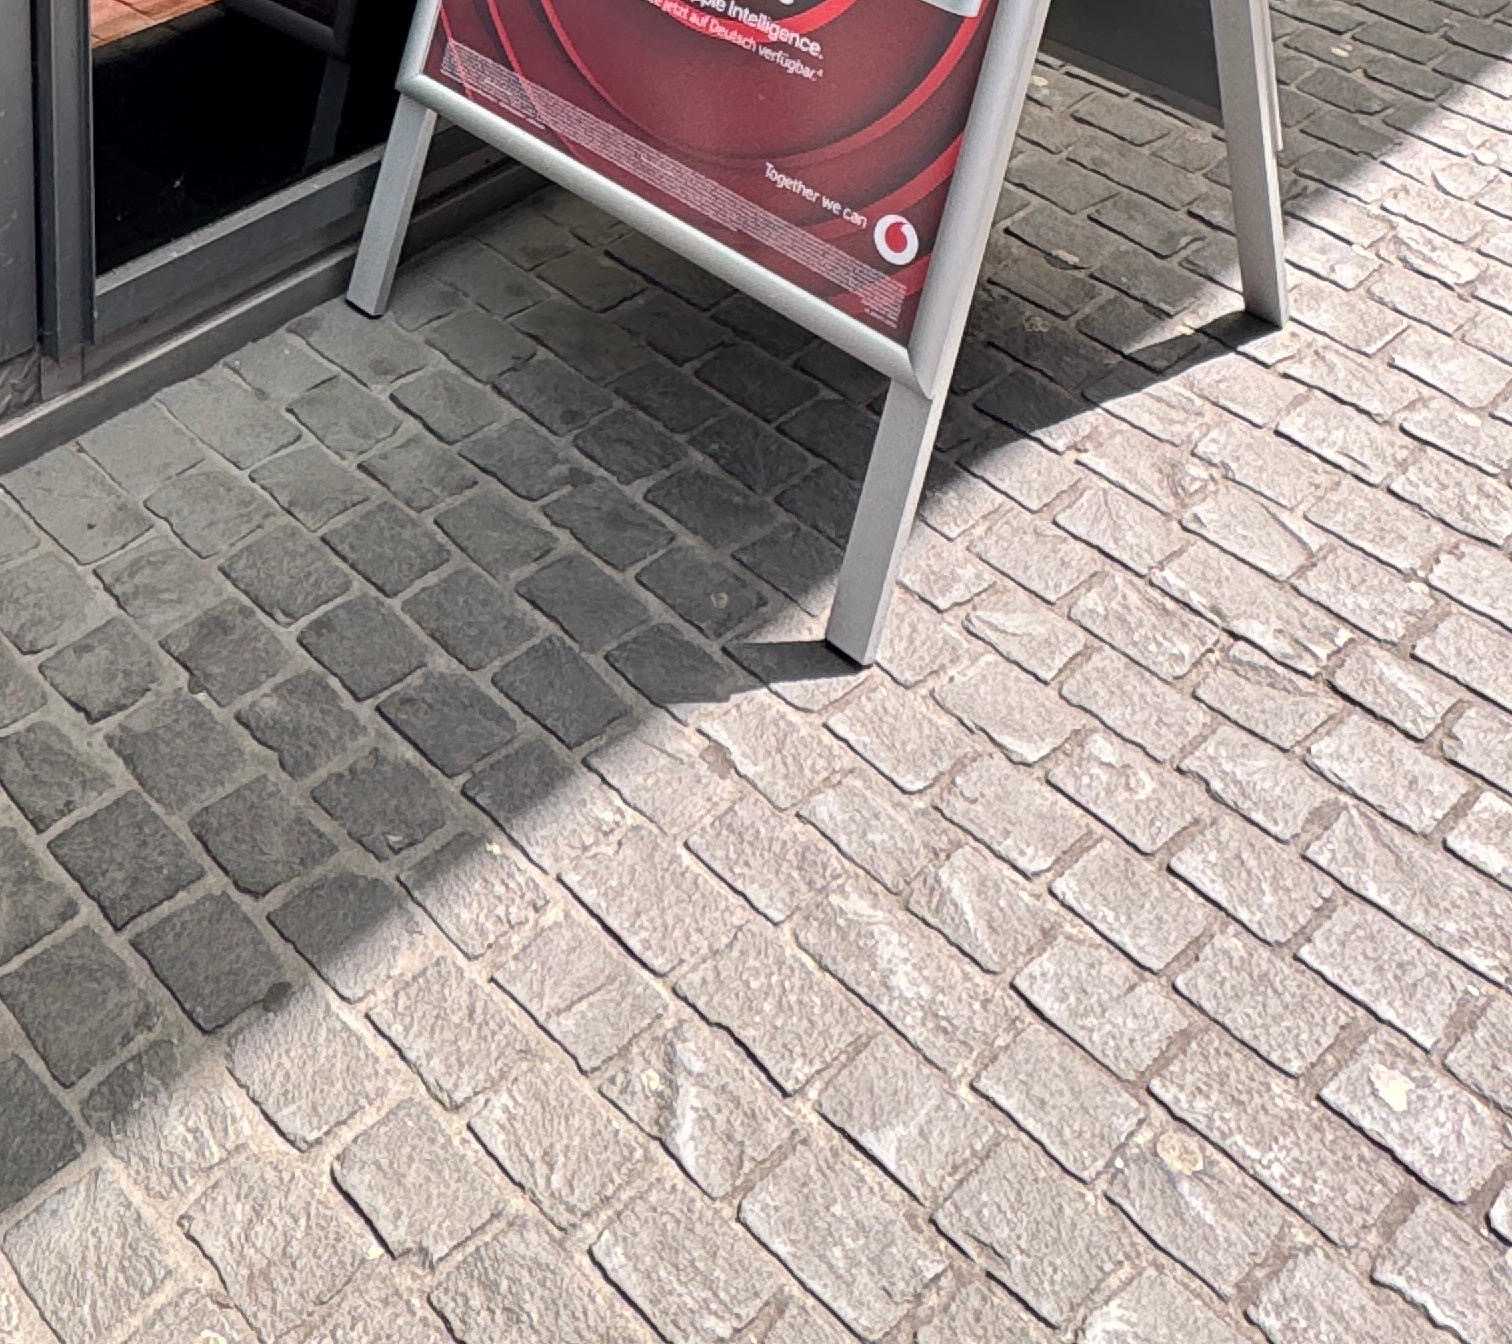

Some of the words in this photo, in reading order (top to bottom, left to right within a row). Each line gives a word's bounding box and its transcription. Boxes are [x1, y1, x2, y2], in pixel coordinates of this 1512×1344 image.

[688, 10, 710, 30] auf
[708, 19, 758, 54] Deutsch
[764, 161, 821, 205] Together
[821, 195, 842, 217] we
[842, 207, 869, 231] can
